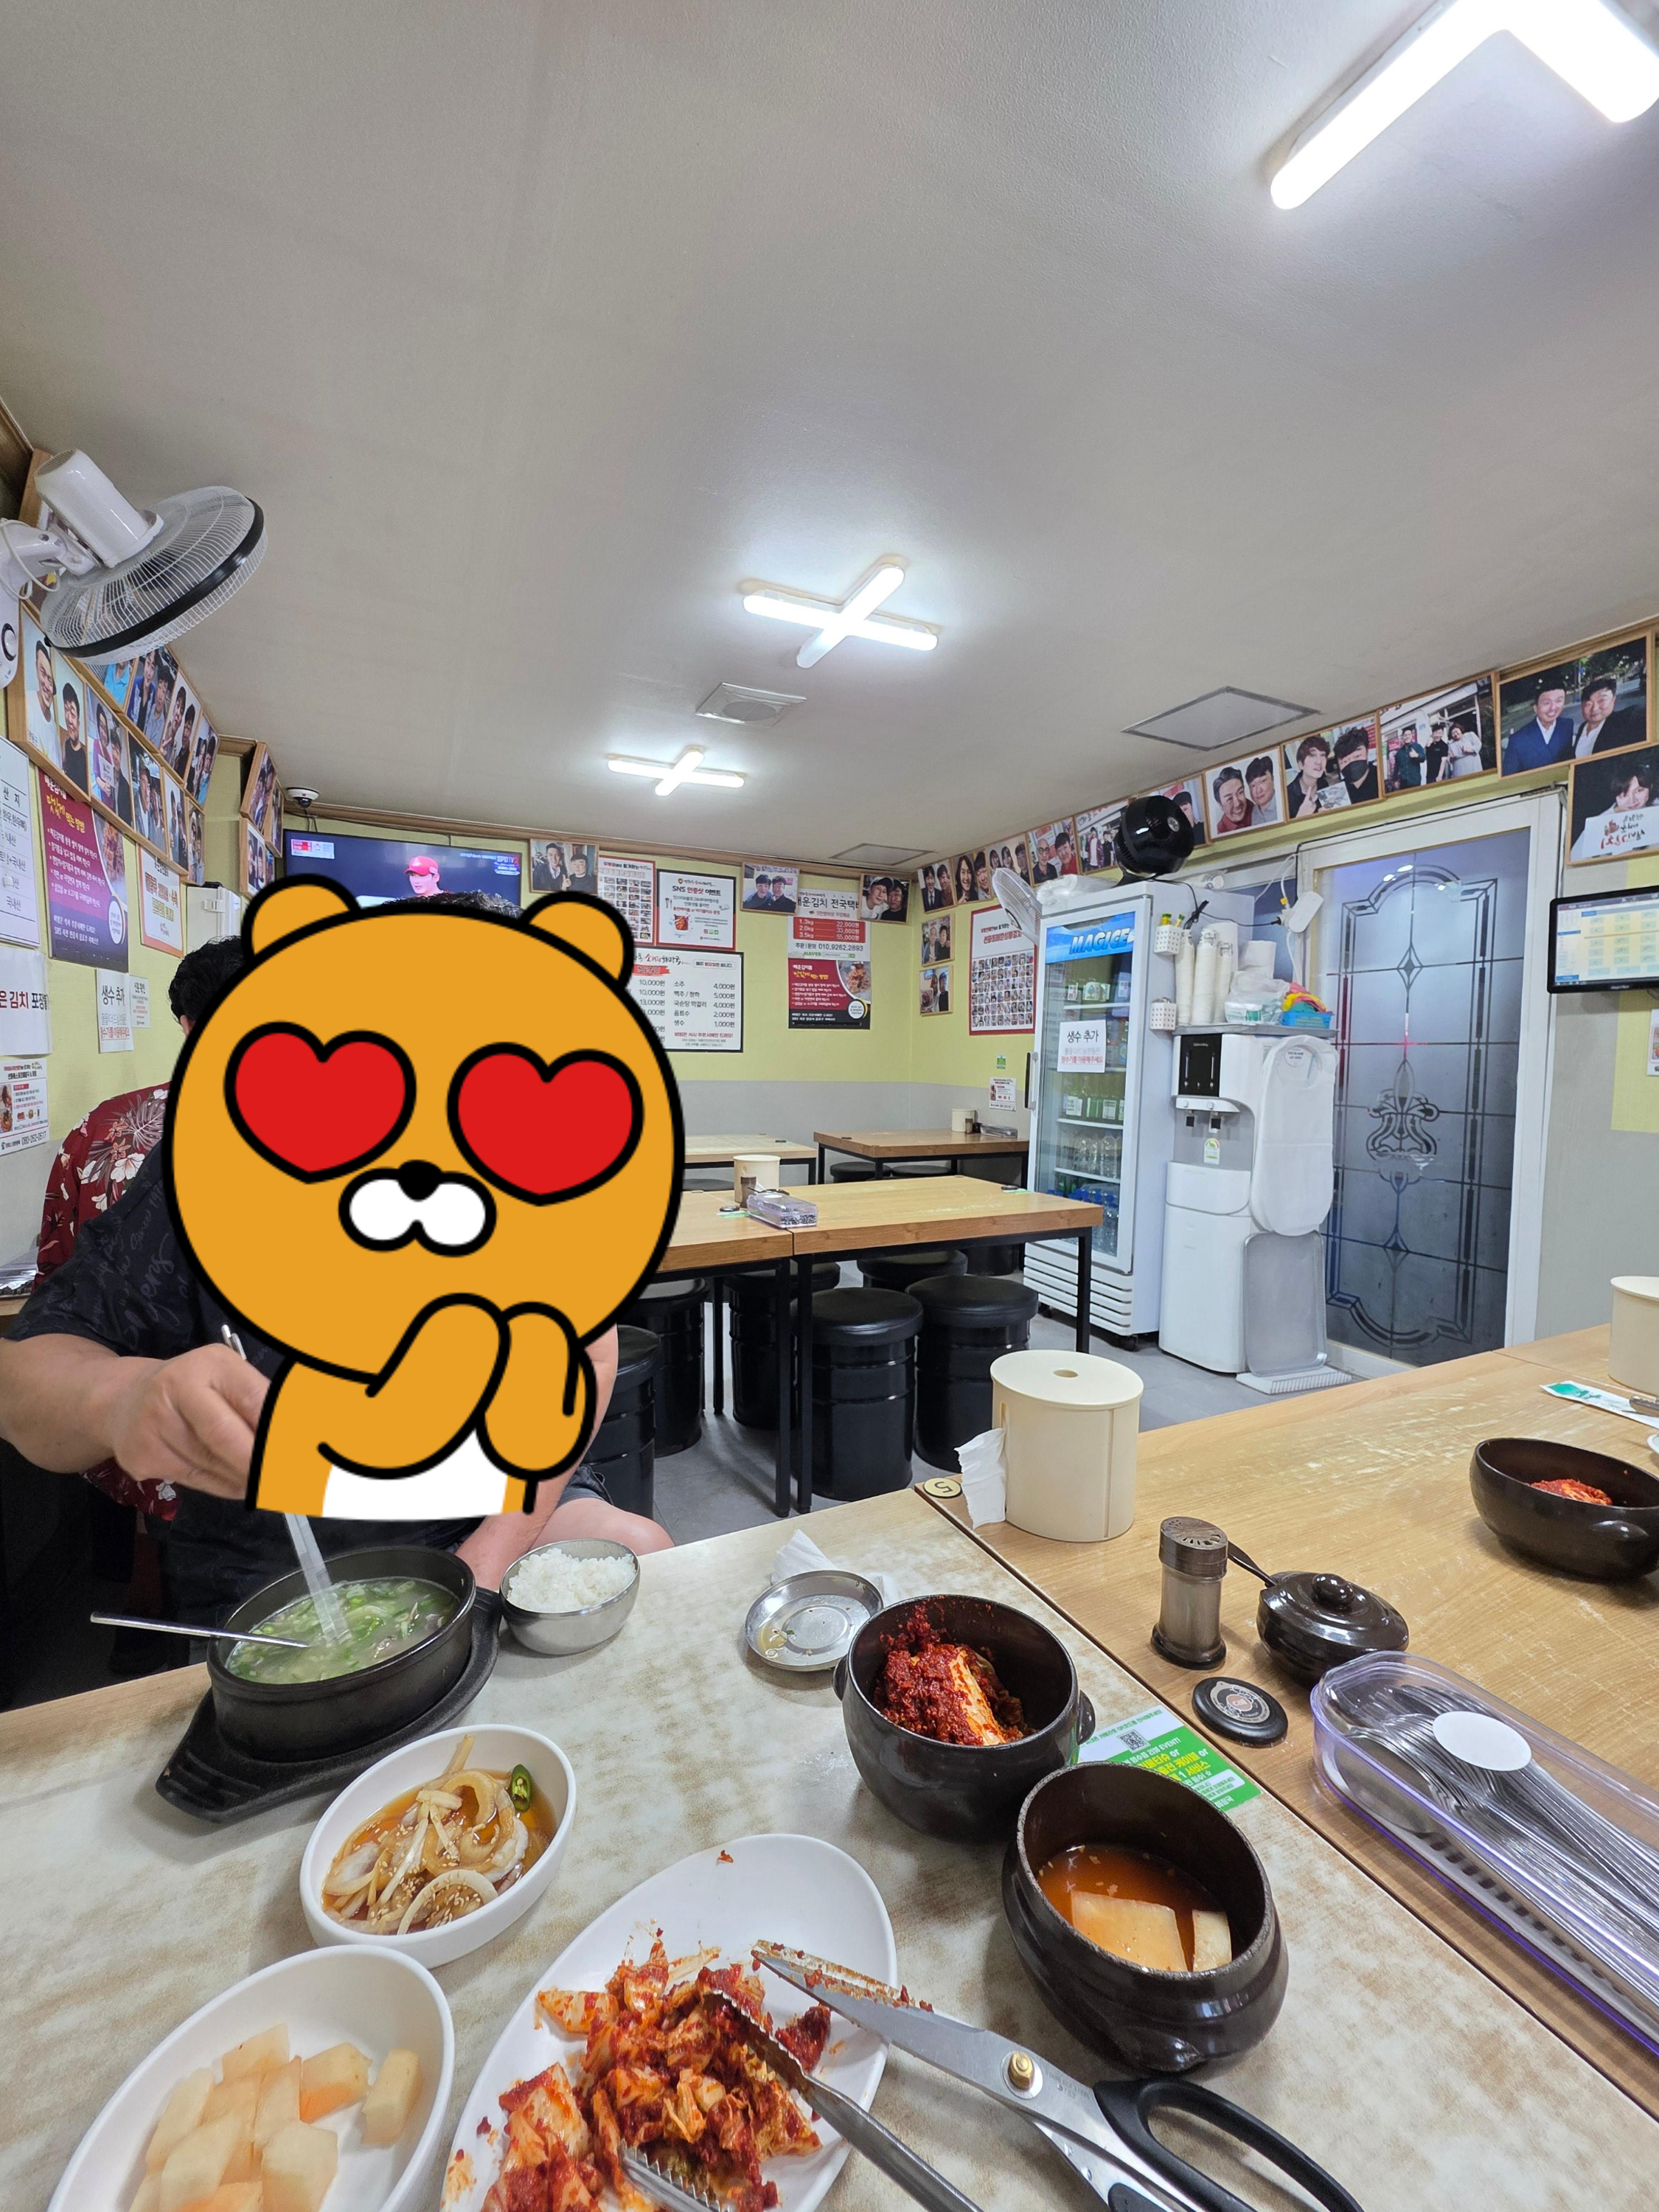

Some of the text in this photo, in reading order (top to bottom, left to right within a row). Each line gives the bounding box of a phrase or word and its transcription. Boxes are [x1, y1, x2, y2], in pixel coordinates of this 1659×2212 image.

[14, 793, 21, 807] 지
[637, 965, 660, 973] MENU
[10, 991, 29, 1009] 김치
[101, 985, 114, 1006] 생수
[1067, 1029, 1099, 1043] 생수 추가
[1160, 1737, 1182, 1752] EVENT!
[1169, 1749, 1181, 1758] or
[1175, 1751, 1201, 1768] 케이블
[1198, 1748, 1210, 1758] or
[1186, 1761, 1211, 1776] 서비스
